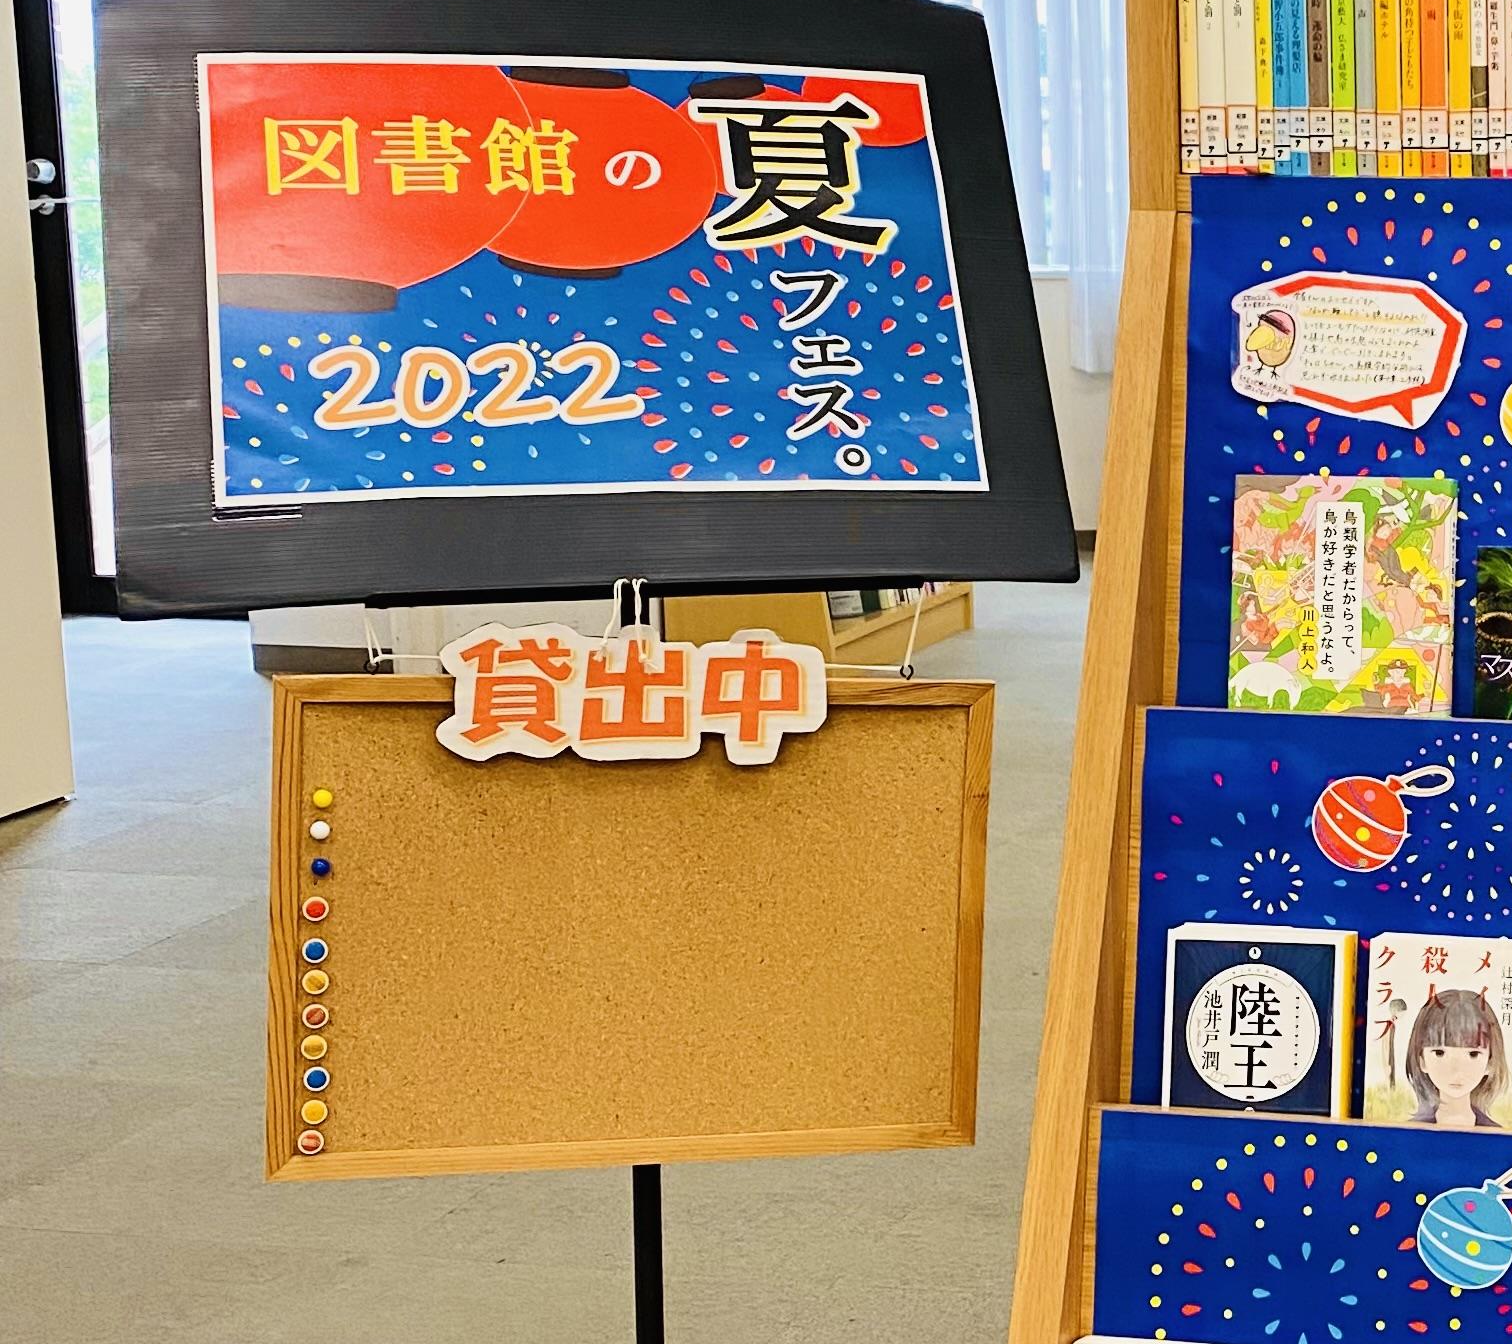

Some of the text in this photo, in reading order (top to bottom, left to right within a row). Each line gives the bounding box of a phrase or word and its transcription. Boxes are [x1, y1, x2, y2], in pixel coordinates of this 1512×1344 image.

[310, 340, 645, 430] 2022
[1319, 507, 1339, 675] 鳥が好きだと思うなよ。
[1341, 508, 1359, 656] 鳥類学者だからって、
[1299, 607, 1315, 673] 川上和人
[459, 637, 803, 744] 貸出中
[1373, 945, 1397, 1043] クラブ
[1420, 945, 1450, 1011] 殺人
[1200, 989, 1225, 1072] 池井戸潤
[1229, 981, 1284, 1092] 陸王
